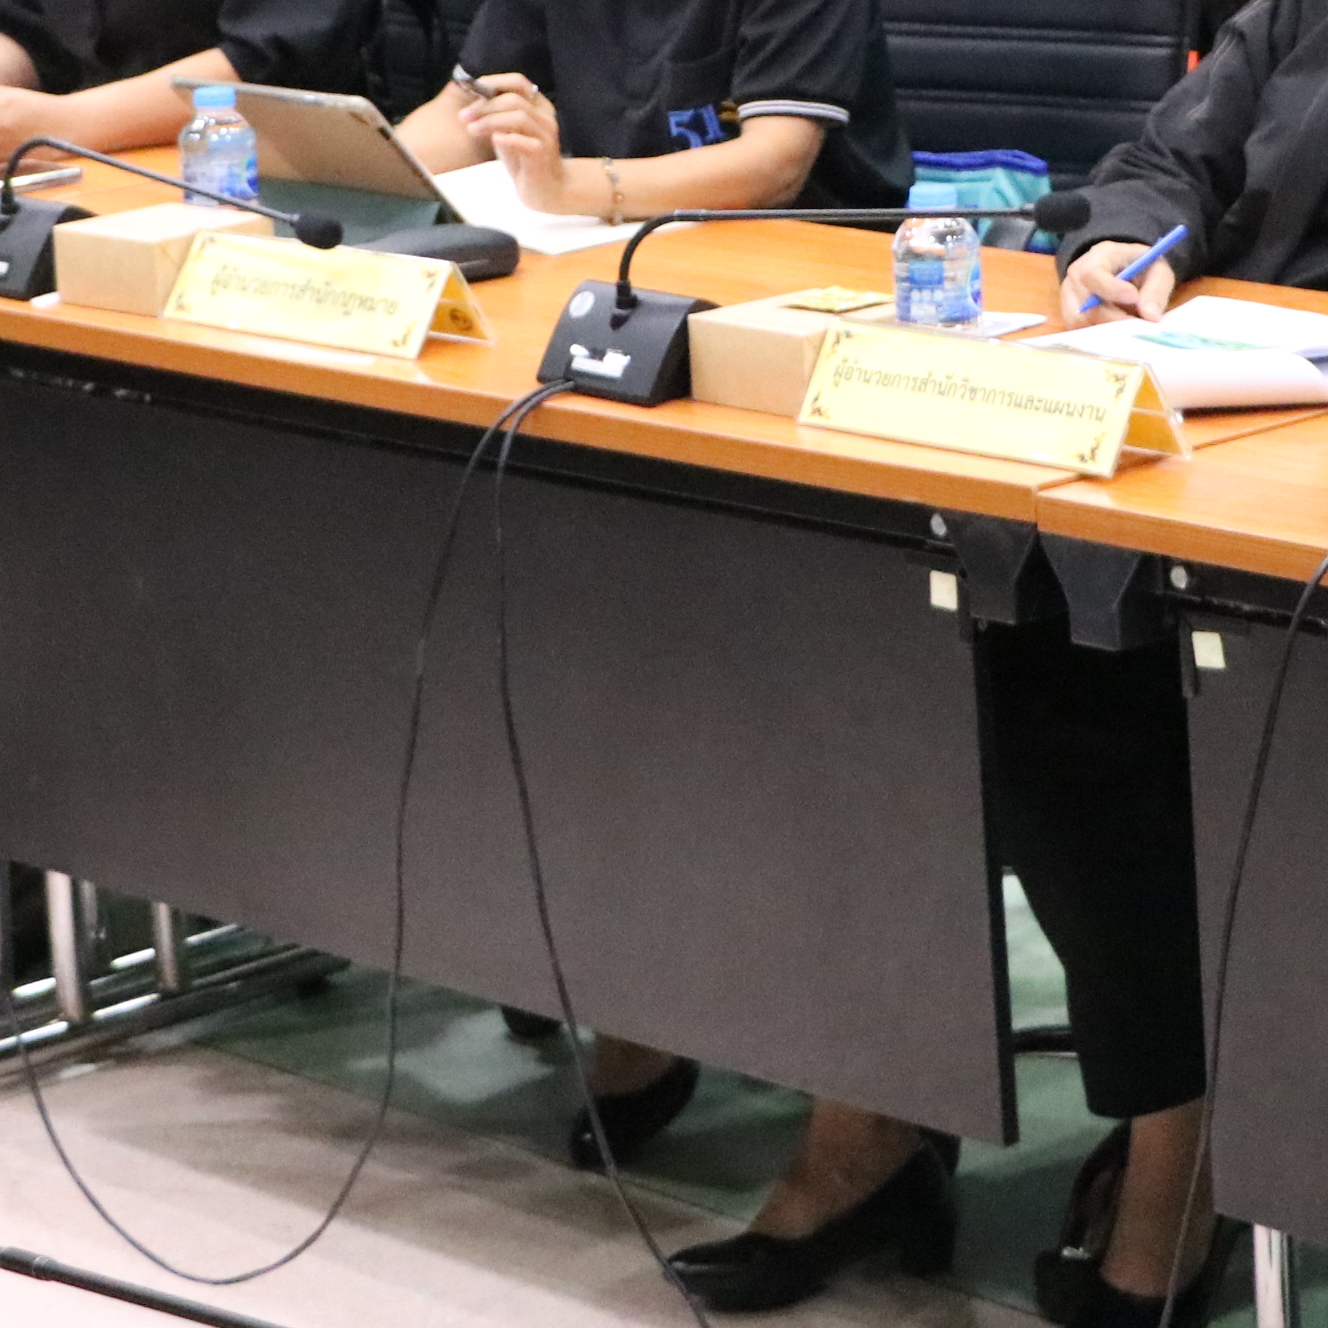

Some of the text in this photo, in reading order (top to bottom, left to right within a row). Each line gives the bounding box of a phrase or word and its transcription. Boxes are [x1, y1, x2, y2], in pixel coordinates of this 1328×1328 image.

[832, 357, 1106, 423] ผู้อำนวยการสำนักวิชาการและแผนงาน
